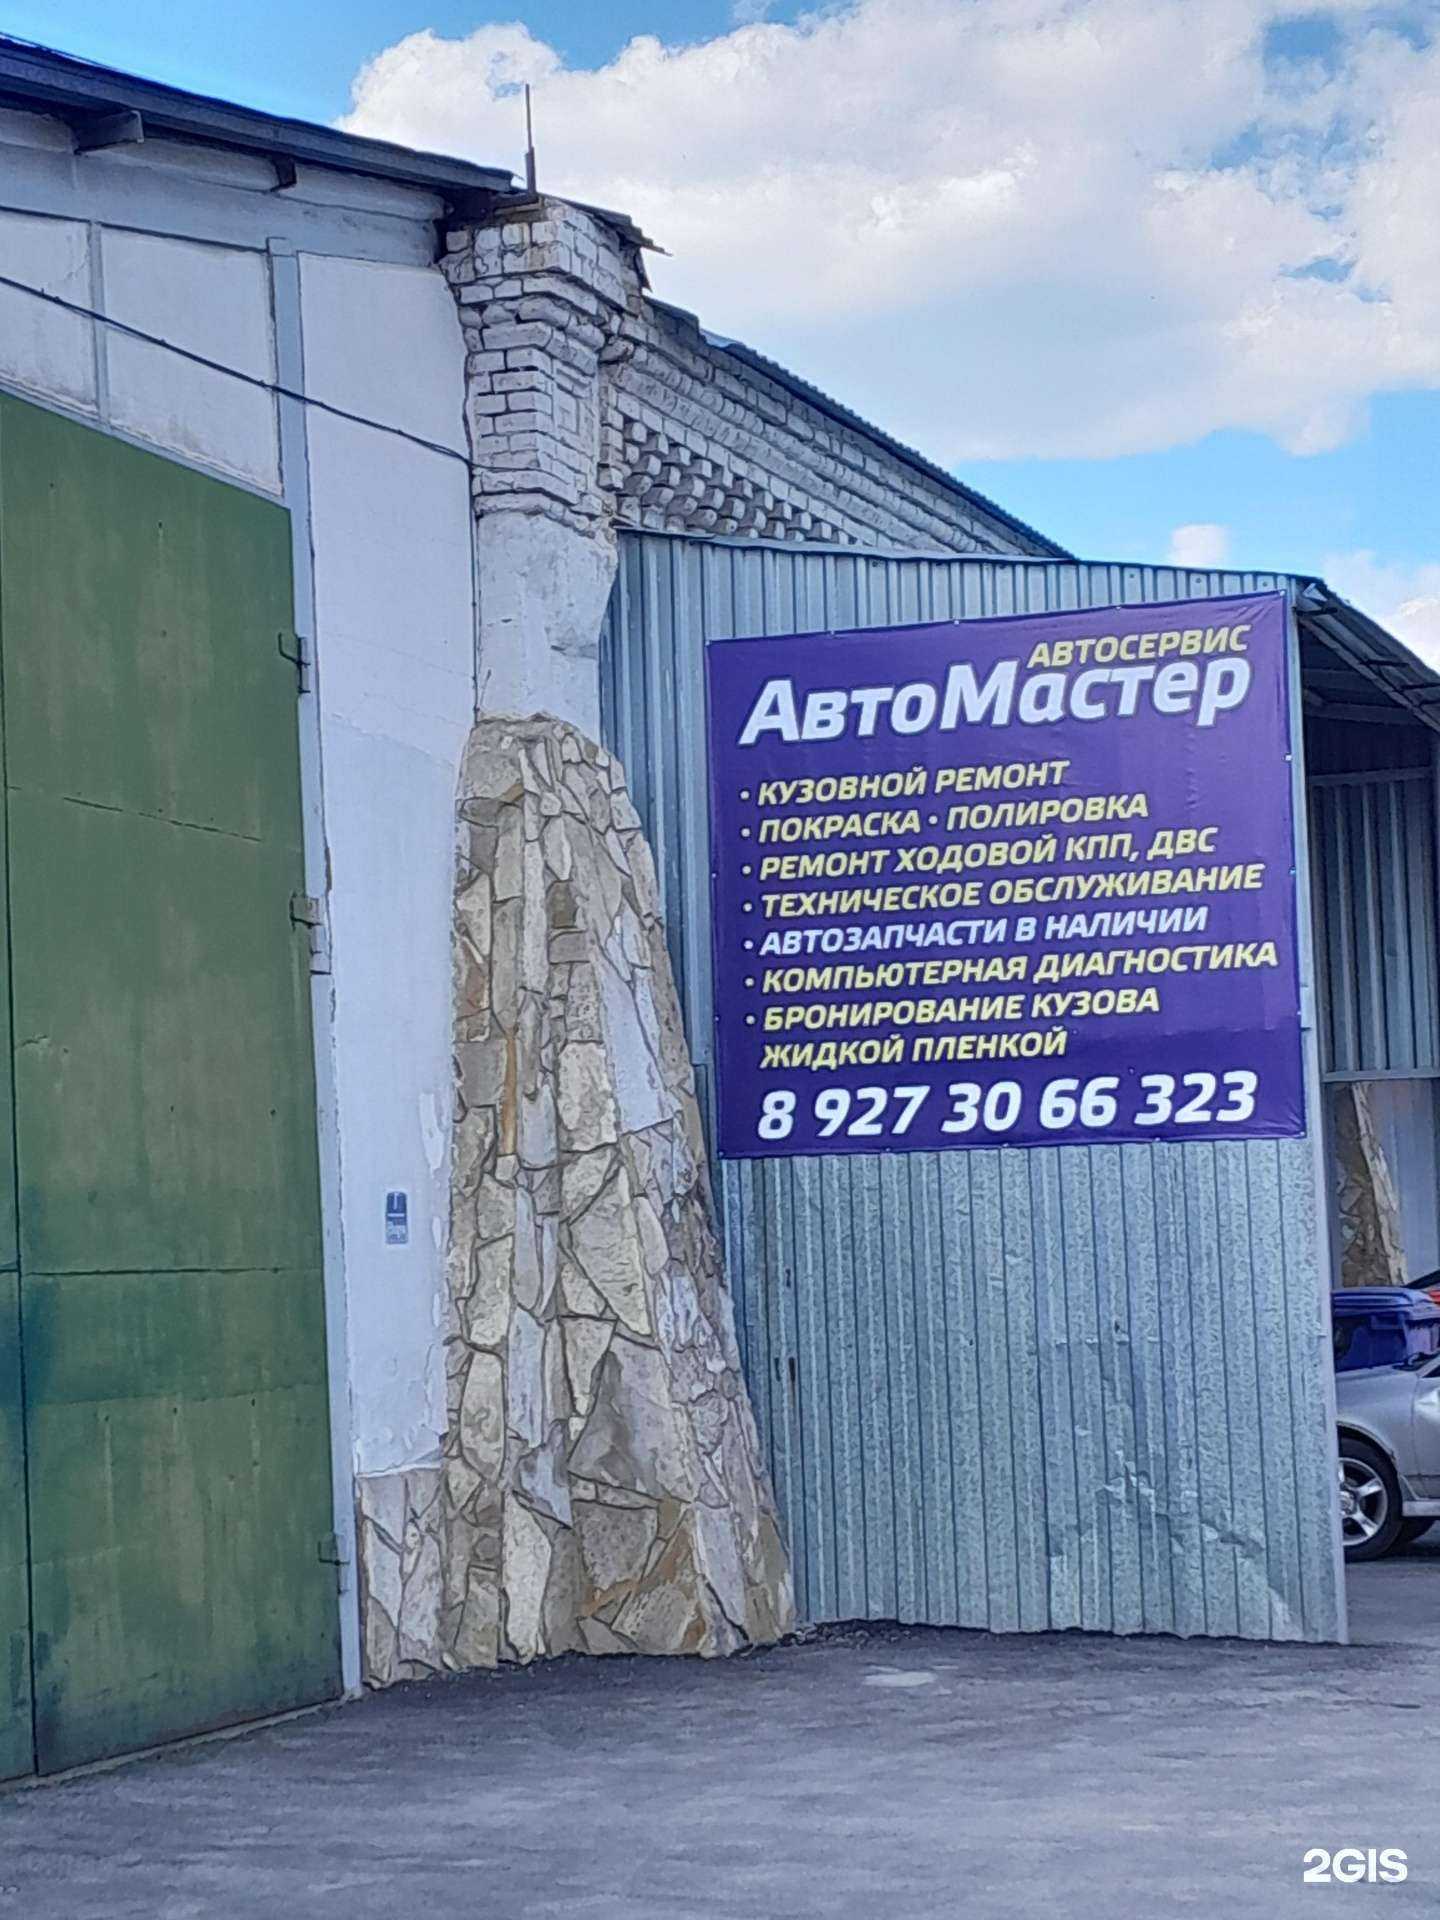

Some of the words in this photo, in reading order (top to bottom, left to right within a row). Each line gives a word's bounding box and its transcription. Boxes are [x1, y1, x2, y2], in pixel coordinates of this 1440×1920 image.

[1028, 624, 1252, 670] АВТОСЕРВИС
[738, 656, 1252, 746] АвтоМастер
[758, 767, 928, 805] КУЗОВНОЙ
[935, 760, 1071, 794] РЕМОНТ
[759, 809, 921, 843] ПОКРАСКА
[946, 794, 1149, 831] ПОЛИРОВКА
[760, 849, 892, 881] РЕМОНТ
[894, 833, 1059, 876] ХОДОВОЙ
[1065, 832, 1139, 865] КПП,
[1147, 827, 1219, 859] ДВС
[762, 882, 980, 918] ТЕХНИЧЕСКОЕ
[989, 864, 1265, 904] ОБСЛУЖИВАНИЕ
[759, 918, 1006, 956] АВТОЗАПЧАСТИ
[1014, 916, 1037, 942] В
[1044, 907, 1209, 941] НАЛИЧИИ
[762, 955, 1027, 993] КОМПЬЮТЕРНАЯ
[1033, 942, 1279, 984] ДИАГНОСТИКА
[763, 995, 1025, 1031] БРОНИРОВАНИЕ
[1031, 987, 1160, 1019] КУЗОВА
[759, 1033, 906, 1071] ЖИДКОЙ
[911, 1025, 1068, 1062] ПЛЕНКОЙ
[757, 1090, 797, 1139] 8
[815, 1084, 931, 1137] 927
[941, 1081, 1021, 1134] 30
[1039, 1076, 1119, 1129] 66
[1134, 1071, 1258, 1126] 323
